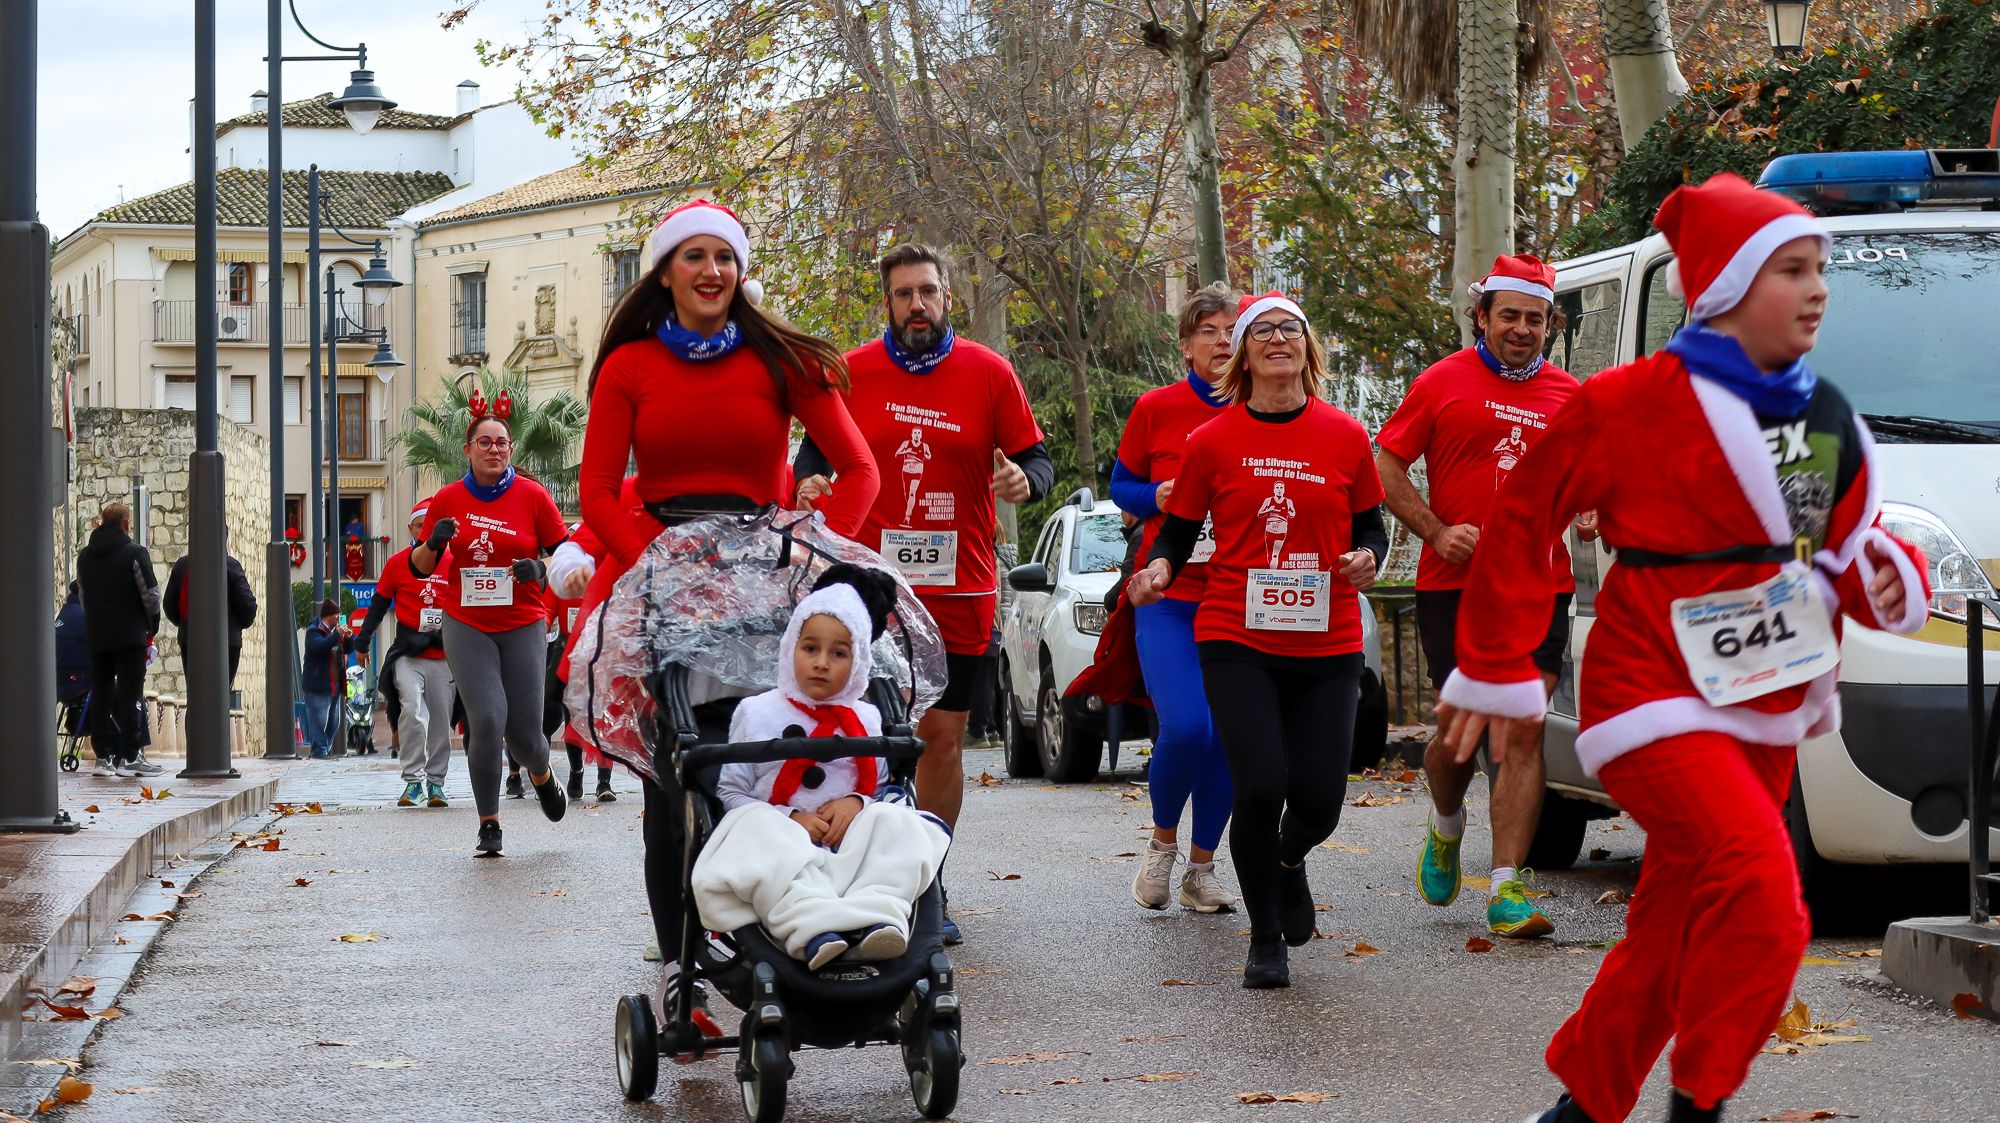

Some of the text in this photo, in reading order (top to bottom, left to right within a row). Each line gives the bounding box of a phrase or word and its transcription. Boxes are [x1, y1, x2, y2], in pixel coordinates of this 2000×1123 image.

[891, 403, 905, 413] San
[906, 405, 940, 419] Silvestre
[1491, 401, 1505, 411] San
[1506, 405, 1539, 419] Silvestre
[895, 412, 961, 433] Ciudad de Lucena
[1495, 411, 1547, 430] Ciudad de Luc
[1248, 457, 1264, 467] San
[1265, 457, 1303, 470] Silvestre
[1253, 467, 1326, 485] Ciudad de Lucena
[470, 513, 480, 521] San
[471, 520, 490, 529] Ciudad
[497, 526, 517, 536] Lucena
[897, 547, 940, 564] 613
[1289, 552, 1319, 561] MEMORIAL
[1281, 560, 1320, 569] JOSE CARLOS
[474, 579, 497, 591] 58
[1262, 588, 1315, 608] 505
[1712, 610, 1797, 659] 641
